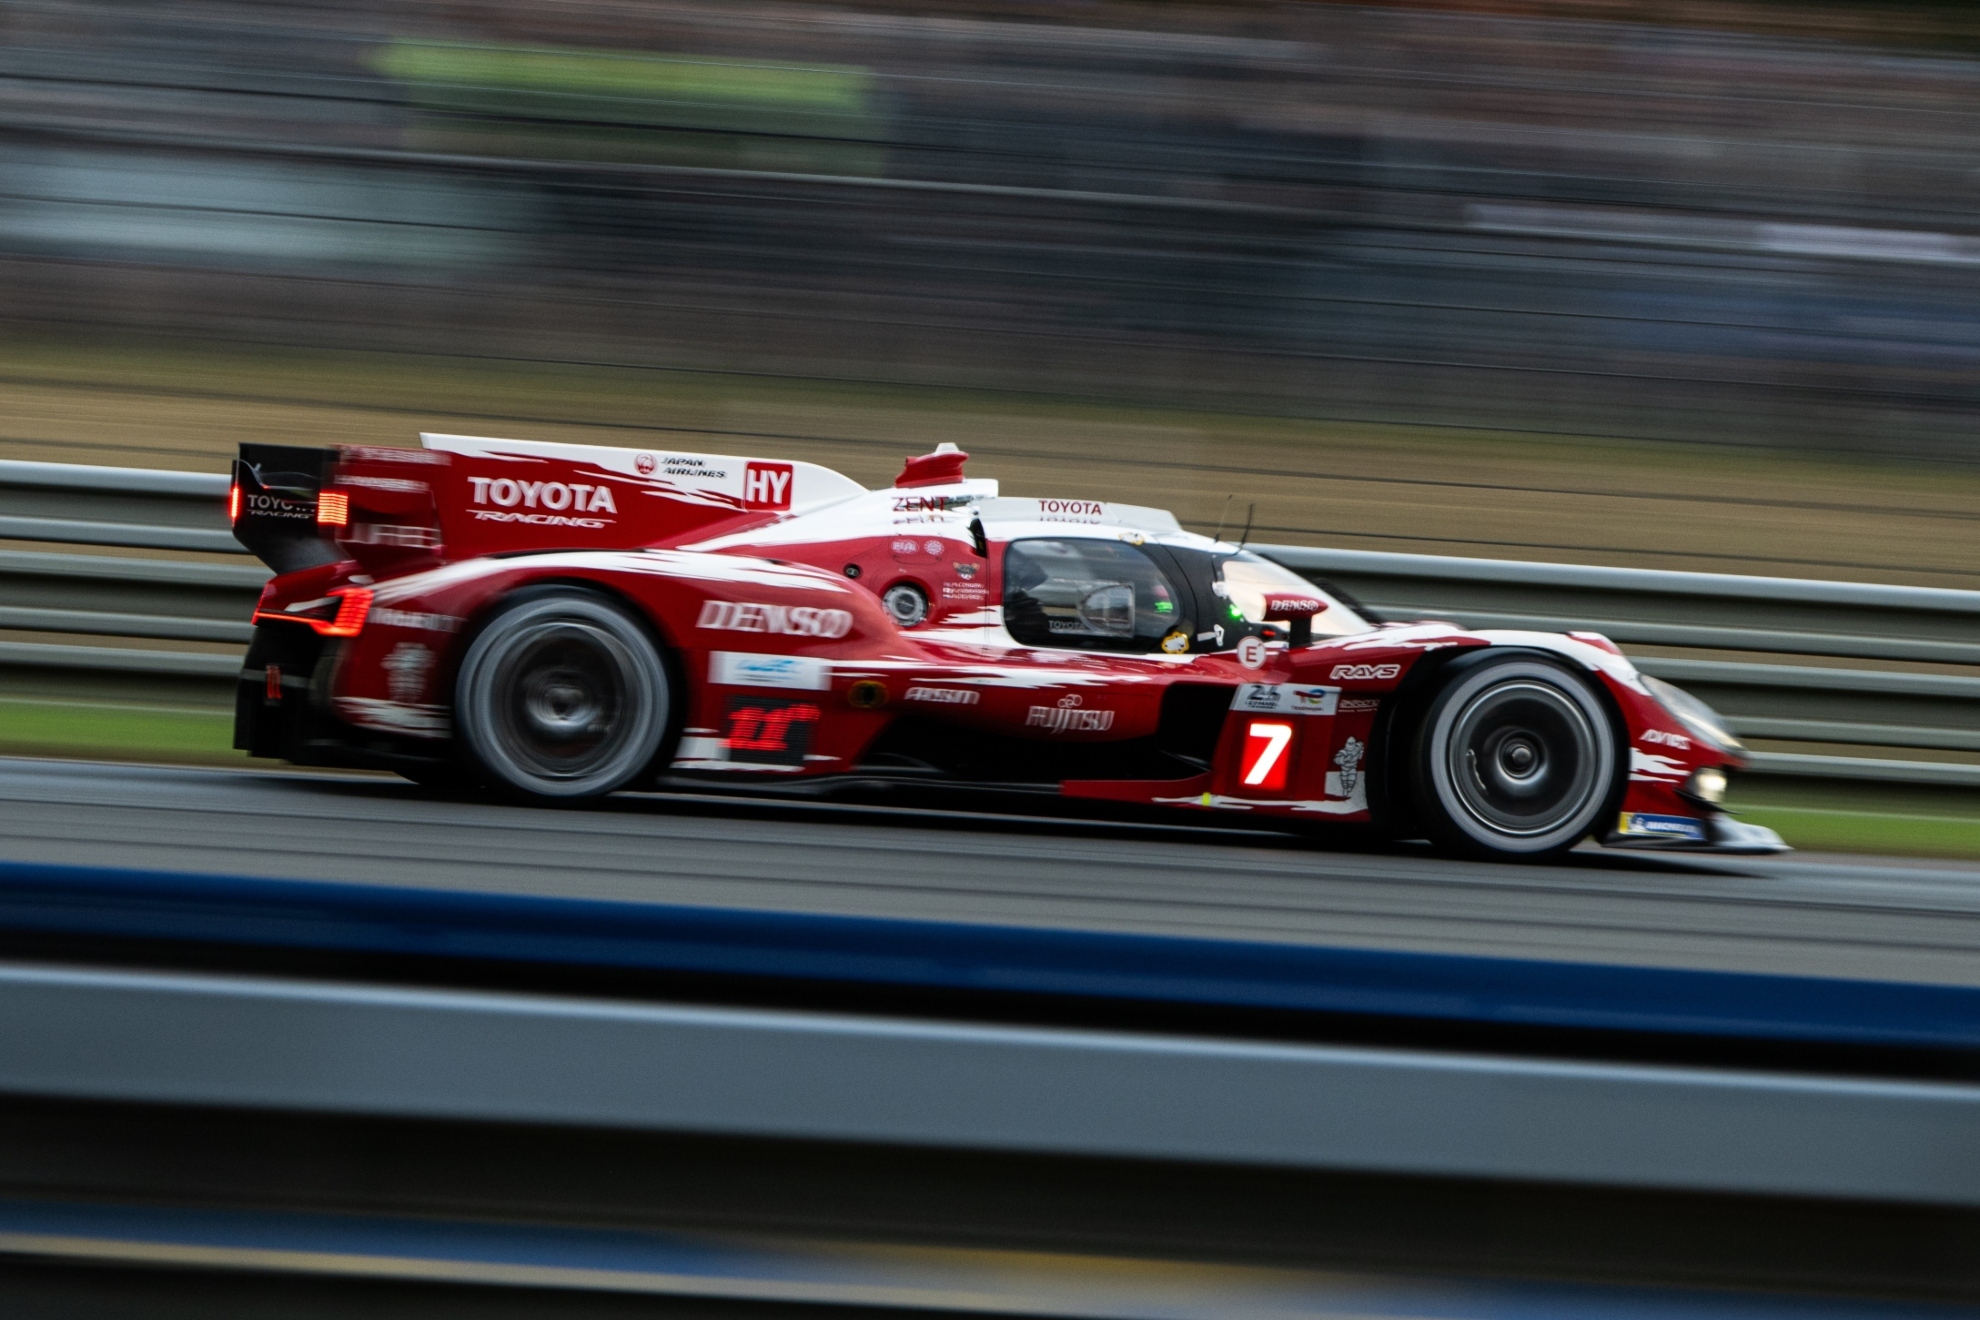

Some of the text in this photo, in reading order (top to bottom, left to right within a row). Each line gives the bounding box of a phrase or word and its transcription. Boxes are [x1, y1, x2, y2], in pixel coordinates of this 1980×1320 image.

[661, 456, 706, 467] JAPAN
[663, 467, 727, 479] AIRLINES
[745, 468, 791, 504] HY
[467, 476, 618, 514] TOYOTA
[891, 496, 950, 512] ZENT
[1039, 499, 1102, 515] TOYOTA
[247, 509, 315, 519] RACING
[465, 509, 617, 529] RACING
[1269, 600, 1320, 612] DENSO
[695, 600, 854, 639] DENSO
[1246, 646, 1258, 662] E
[1329, 664, 1401, 680] RAYS
[1025, 706, 1115, 734] FUJITSU
[1244, 723, 1292, 785] 7
